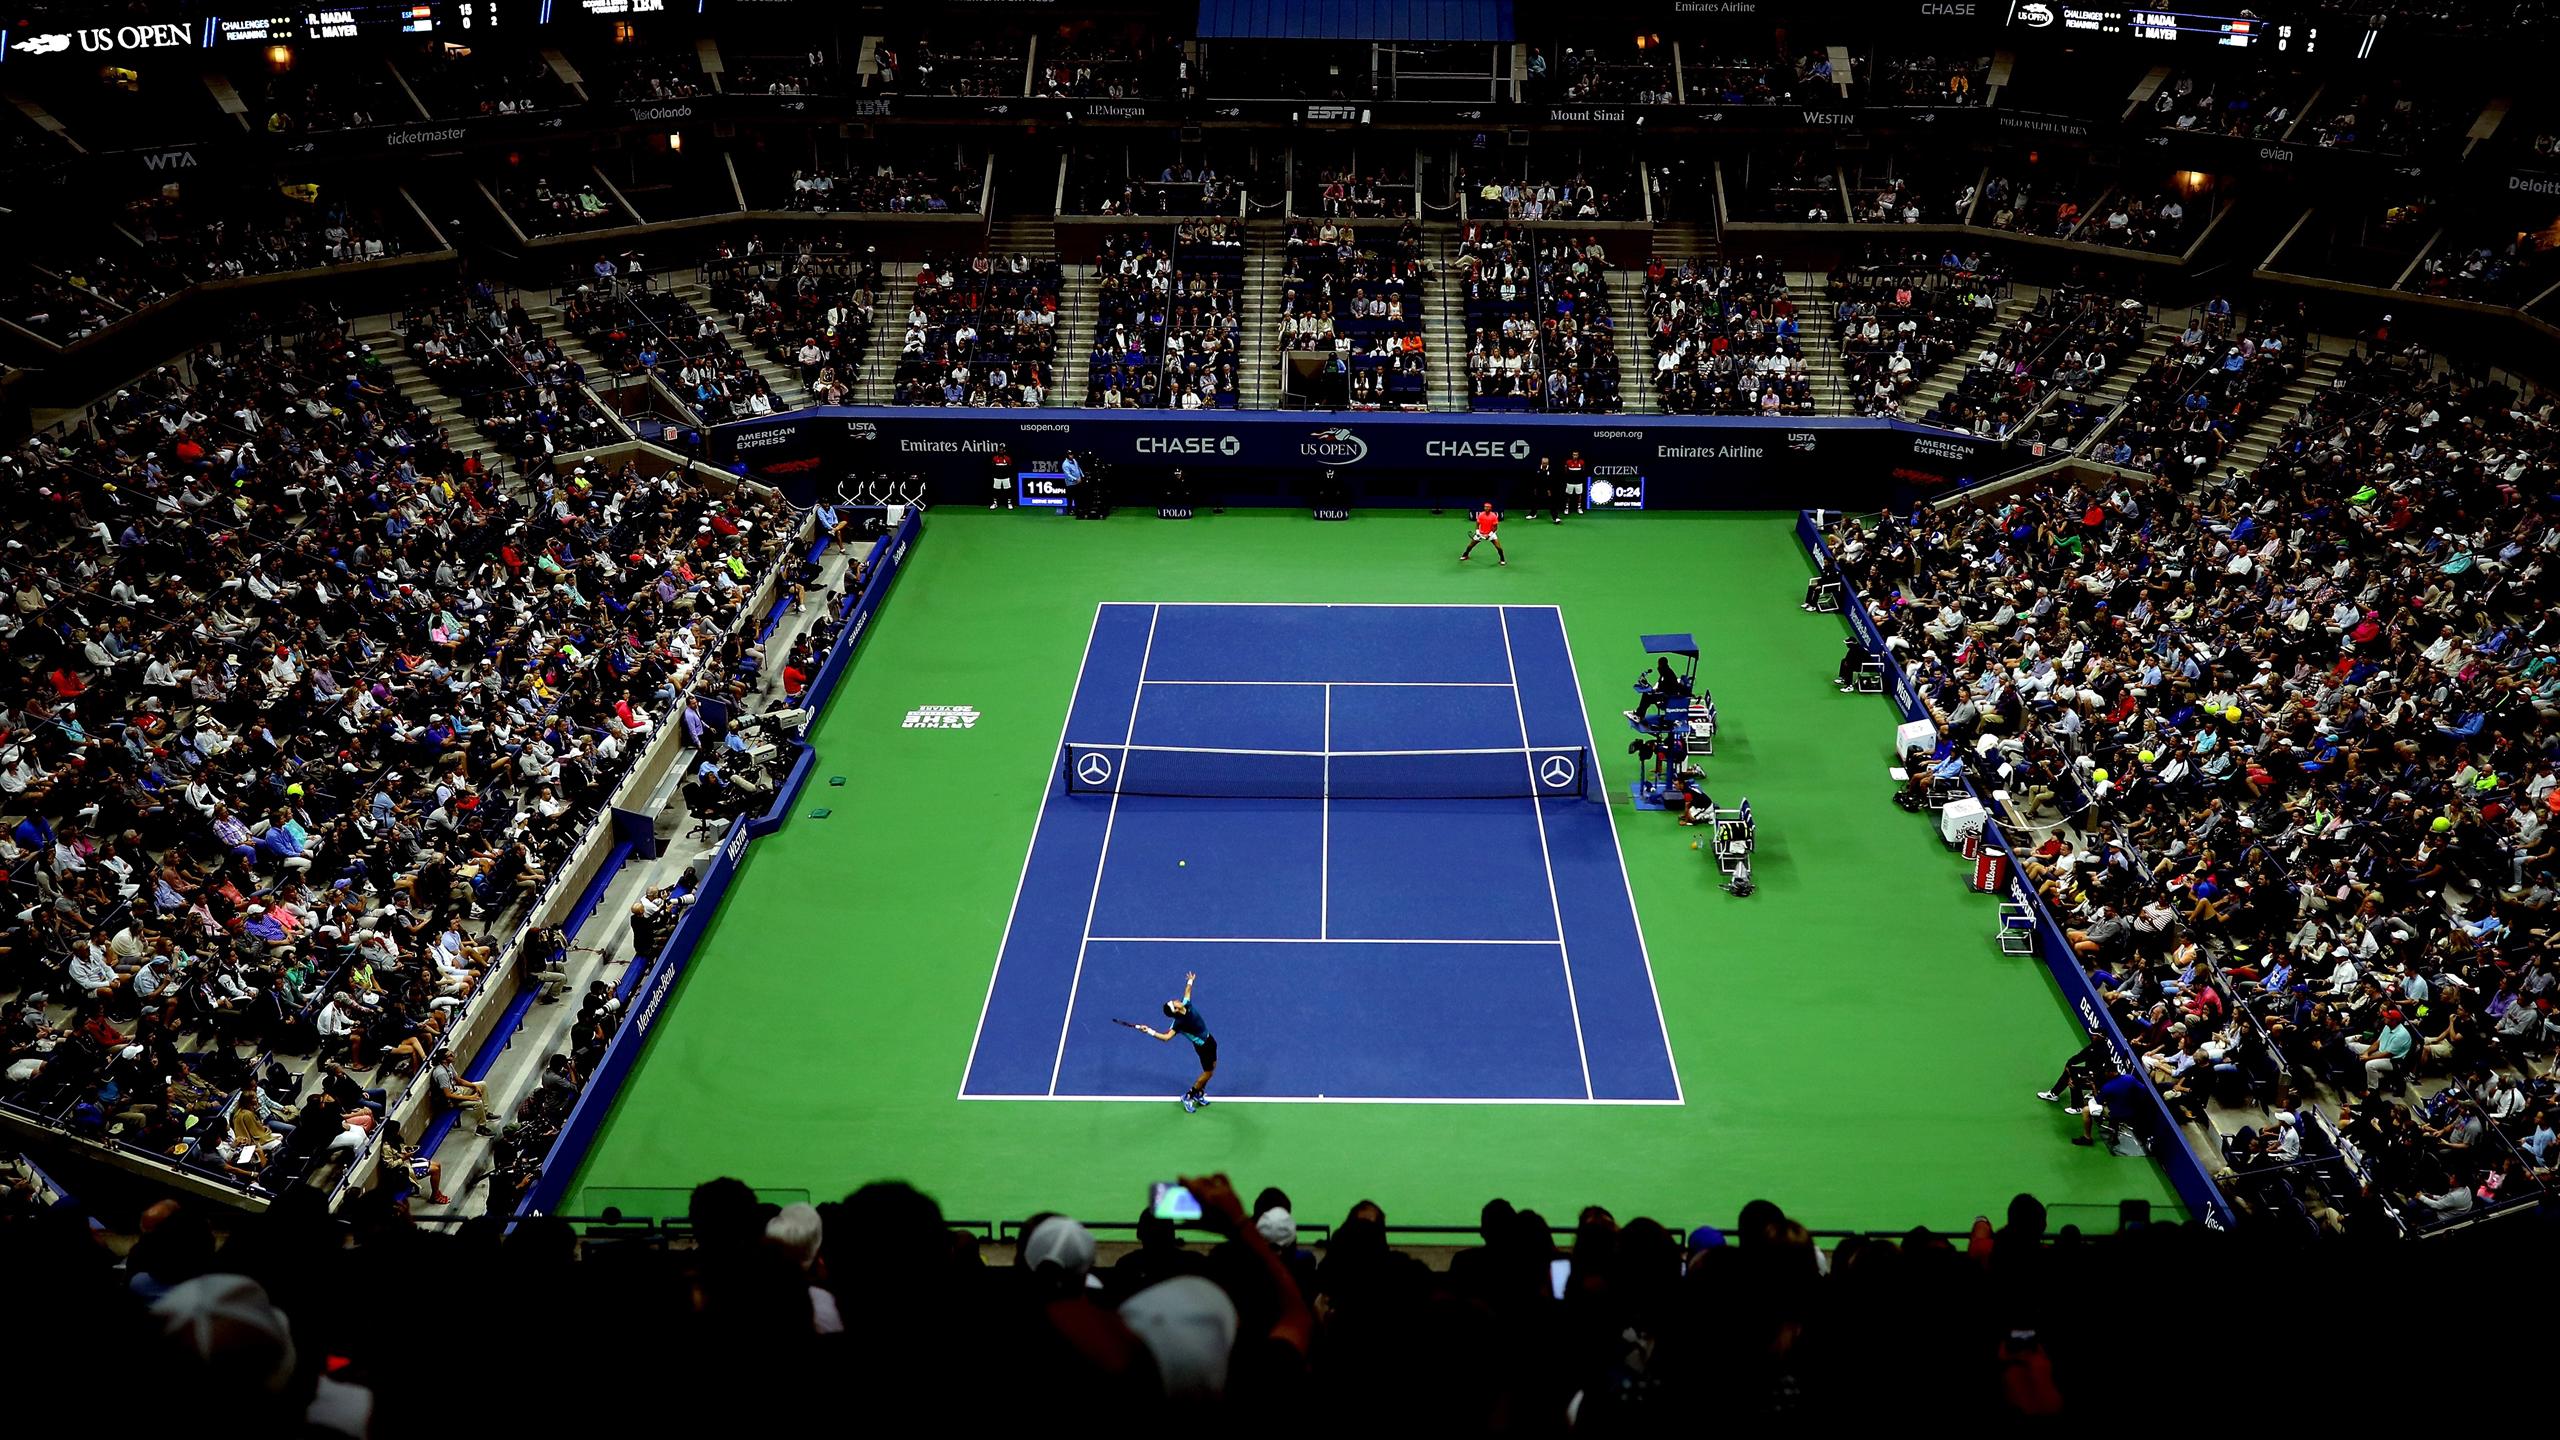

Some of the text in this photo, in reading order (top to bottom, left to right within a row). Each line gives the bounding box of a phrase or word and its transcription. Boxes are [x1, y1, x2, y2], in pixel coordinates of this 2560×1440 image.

[633, 0, 664, 12] IBM
[1676, 1, 1755, 12] Emirates Airline
[1922, 3, 1975, 16] CHASE
[308, 13, 320, 25] R.
[320, 11, 355, 25] NADAL
[459, 4, 472, 15] 15
[490, 2, 497, 13] 3
[2018, 12, 2050, 22] US OPEN
[2064, 9, 2103, 21] CHALLENGES
[222, 18, 269, 32] CHALLENGES
[310, 27, 321, 39] L.
[322, 24, 358, 38] MAYER
[462, 17, 471, 29] 0
[490, 15, 498, 26] 2
[2065, 20, 2099, 31] REMAINING
[2136, 13, 2146, 24] R.
[2147, 14, 2177, 27] NADAL
[2278, 26, 2291, 38] 15
[2309, 28, 2317, 39] 3
[77, 22, 191, 52] US OPEN
[226, 28, 267, 41] REMAINING
[2134, 27, 2144, 38] L.
[2145, 28, 2177, 41] MAYER
[2278, 39, 2287, 51] 0
[2307, 42, 2315, 52] 2
[856, 99, 890, 116] IBM
[1308, 105, 1355, 120] ESPN
[1552, 109, 1624, 121] Mount Sinai
[388, 128, 465, 146] ticketmaster
[2261, 146, 2292, 162] evian
[144, 151, 196, 171] WTA
[848, 422, 876, 431] USTA
[1021, 424, 1069, 433] usopen.org
[736, 427, 796, 442] AMERICAN
[1594, 431, 1642, 440] usopen.org
[1788, 433, 1816, 442] USTA
[736, 437, 786, 450] EXPRESS
[901, 439, 957, 452] Emirates
[1137, 437, 1215, 454] CHASE
[1301, 443, 1358, 456] US OPEN
[1426, 440, 1505, 457] CHASE
[1915, 439, 1975, 454] AMERICAN
[1659, 445, 1763, 458] Emirates Airline
[1914, 446, 1964, 459] EXPRESS
[1032, 461, 1059, 473] IBM
[1594, 465, 1637, 476] CITIZEN
[1027, 481, 1053, 494] 116
[1615, 486, 1641, 498] 0:24
[1161, 508, 1187, 518] POLO
[1318, 508, 1344, 519] POLO
[1984, 859, 1997, 890] Wilson
[636, 963, 676, 1037] Mercedes-Benz
[2080, 996, 2099, 1029] DEAN
